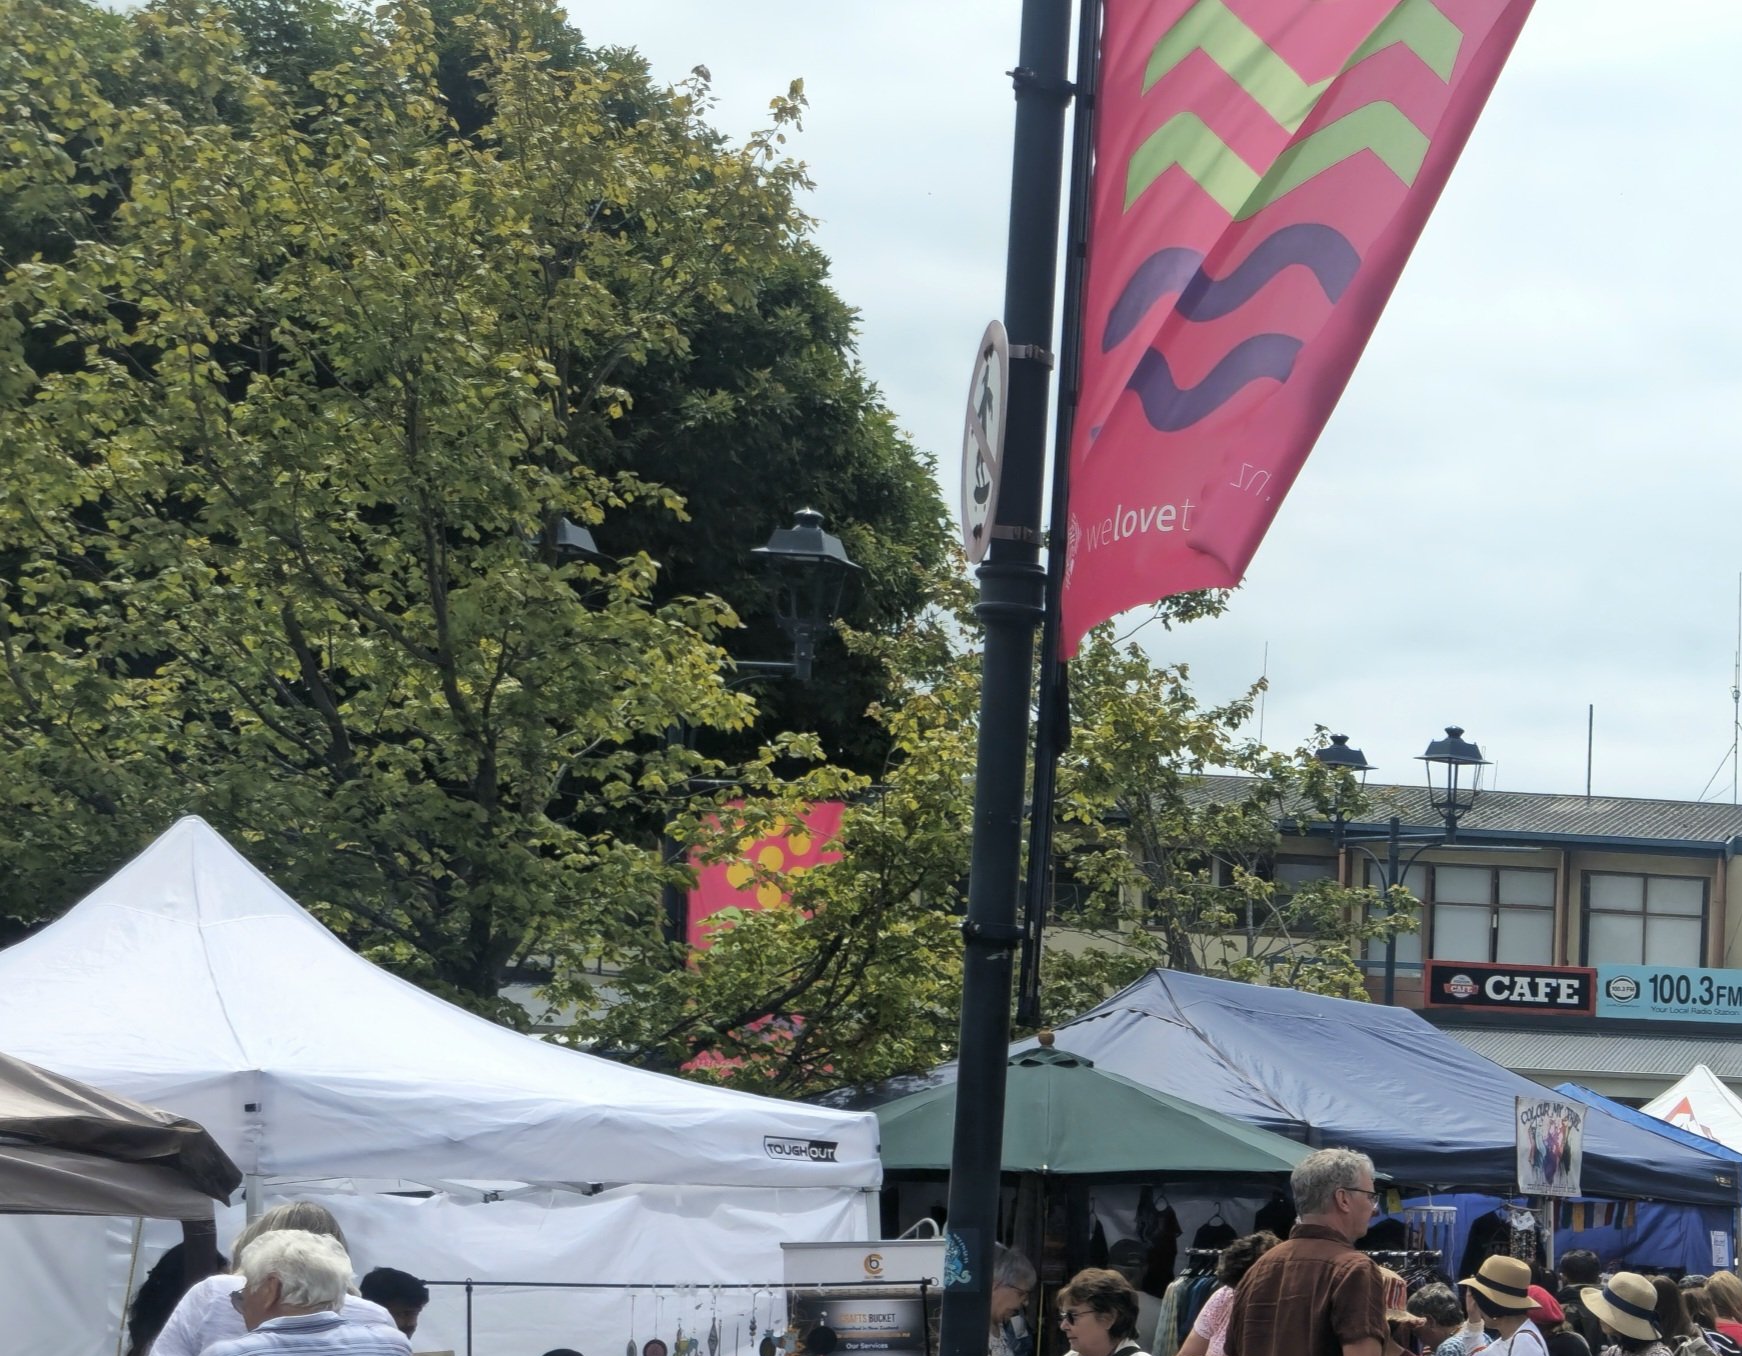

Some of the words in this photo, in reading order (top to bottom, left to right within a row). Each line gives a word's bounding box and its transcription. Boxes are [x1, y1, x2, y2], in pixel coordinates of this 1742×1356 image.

[1450, 985, 1473, 993] CAFE
[1485, 975, 1580, 1004] CAFE
[1651, 1006, 1667, 1014] Your
[1691, 1007, 1712, 1015] Radio
[868, 1313, 896, 1323] BUCKET
[845, 1342, 858, 1350] Our
[860, 1342, 889, 1350] Services
